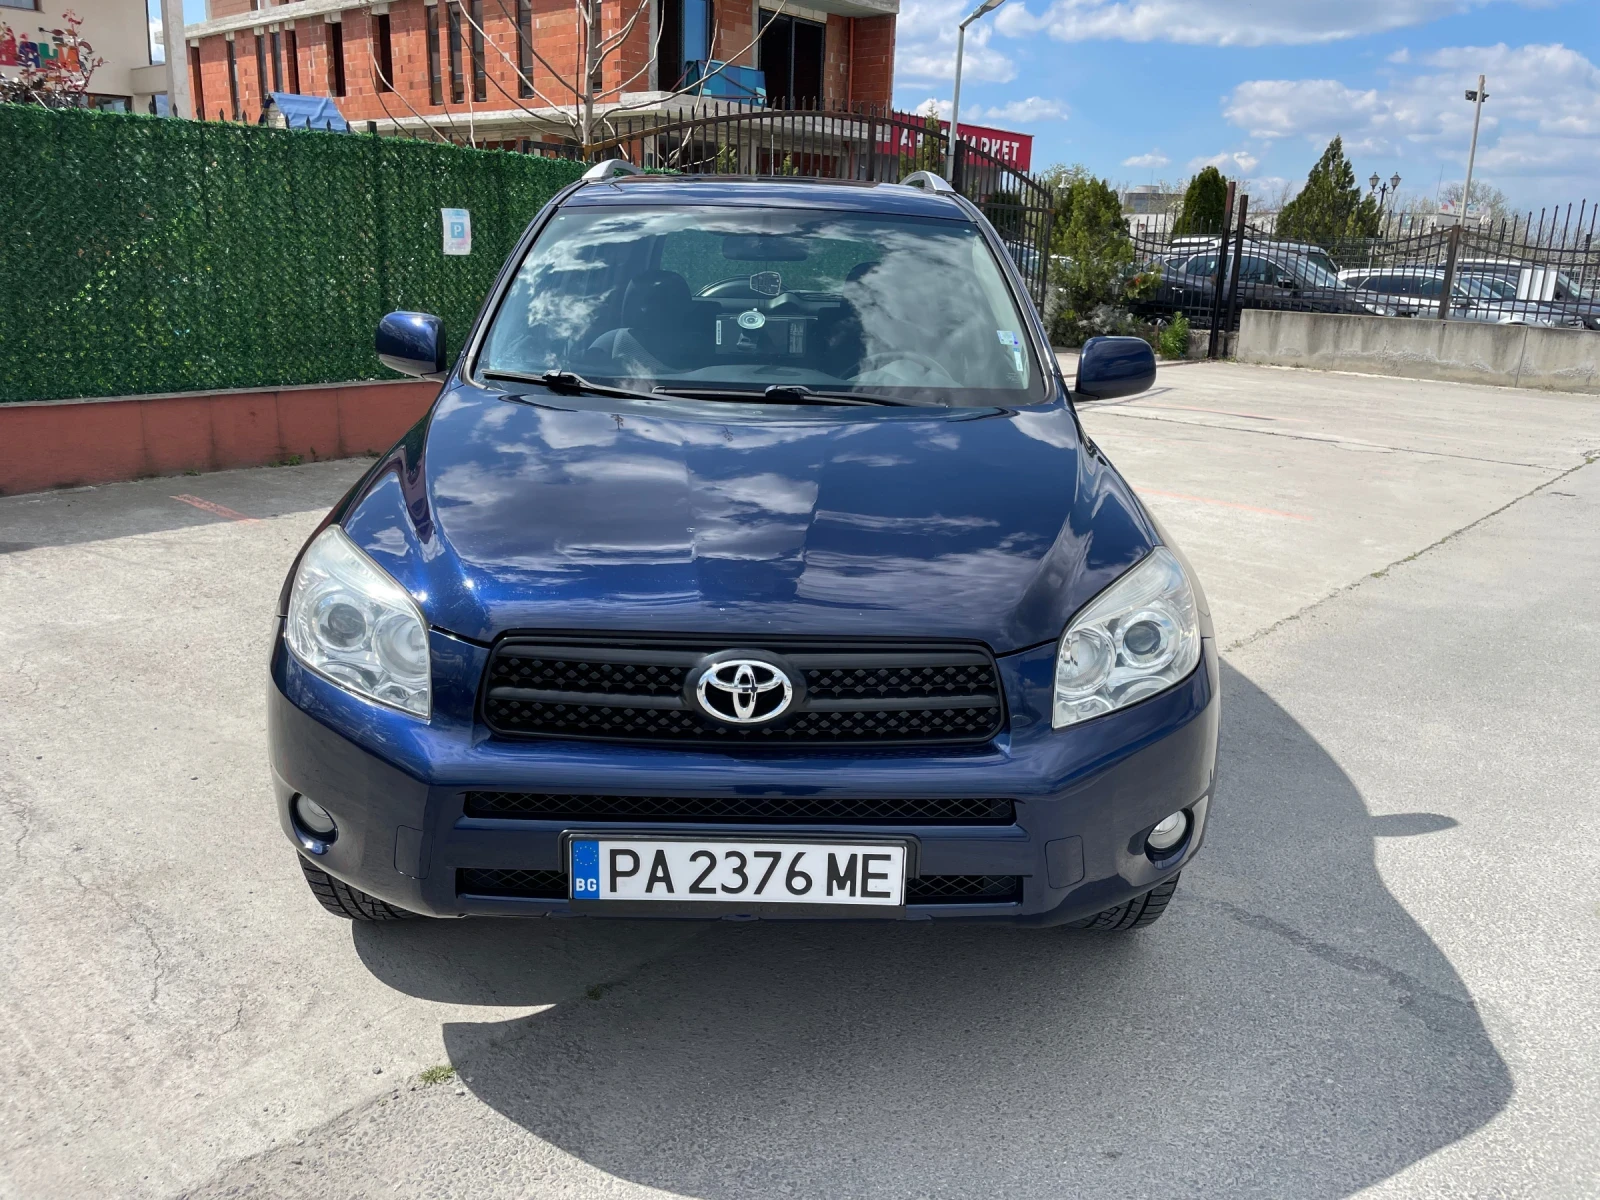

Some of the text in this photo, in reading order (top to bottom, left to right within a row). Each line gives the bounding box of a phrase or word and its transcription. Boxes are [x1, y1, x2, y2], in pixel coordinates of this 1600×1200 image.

[575, 878, 597, 892] BG
[609, 848, 892, 899] PA 2376 ME
